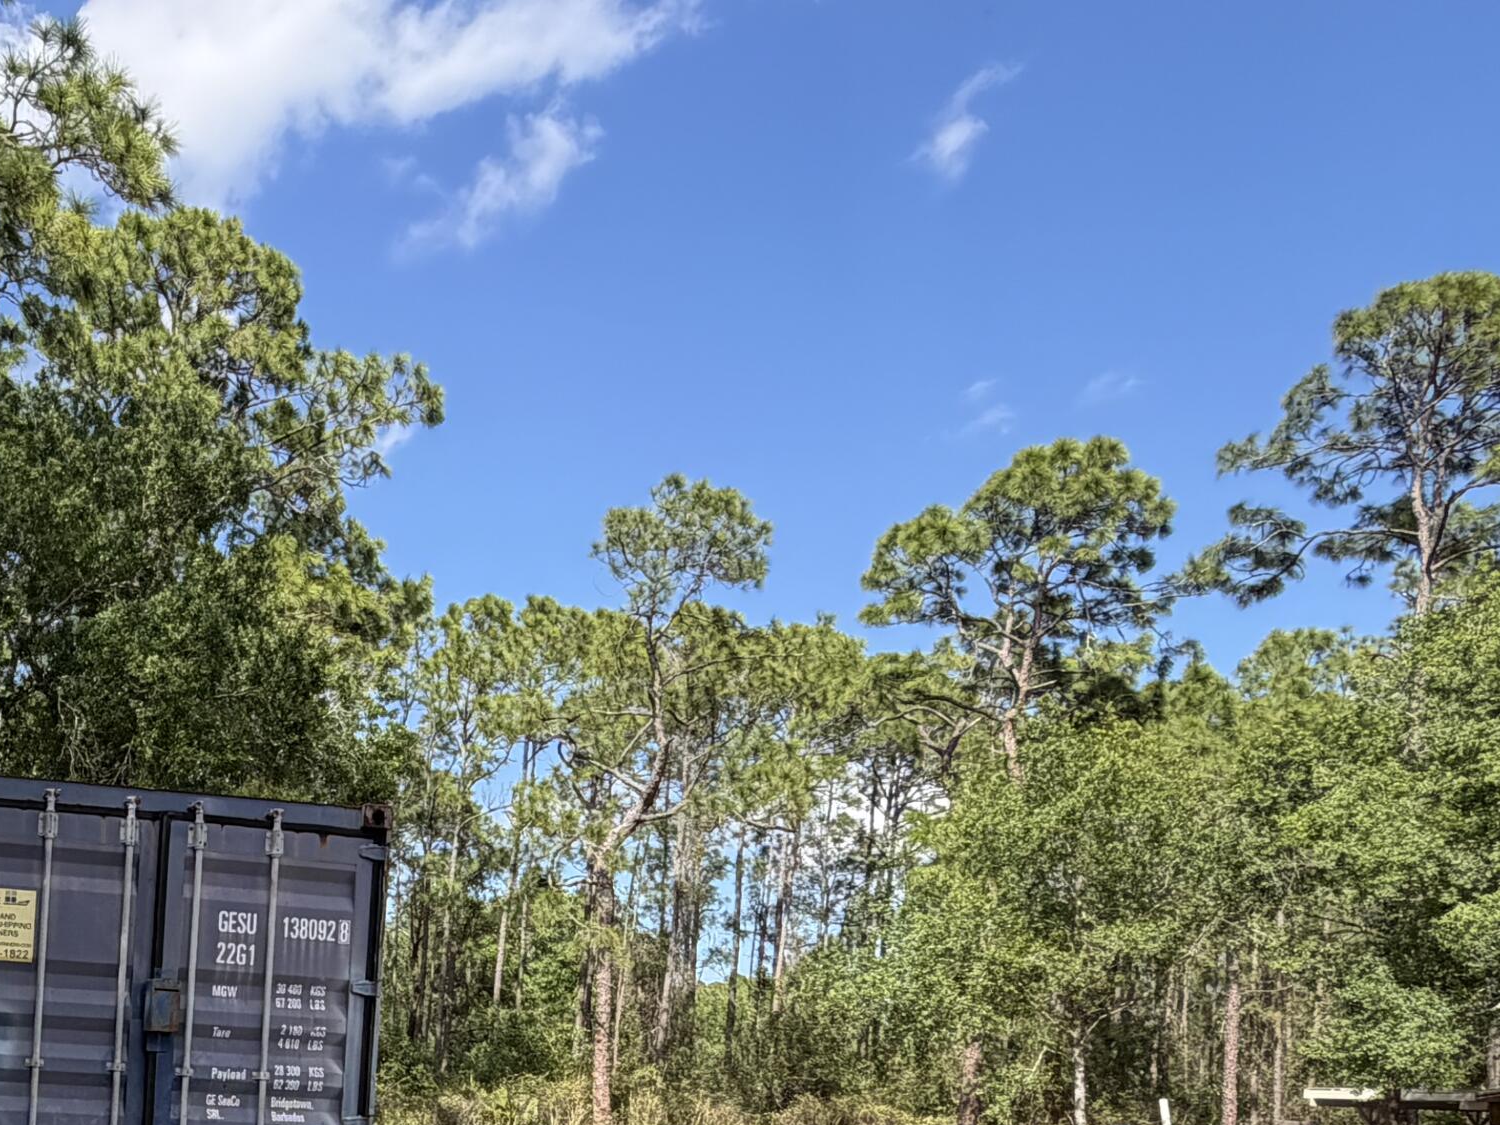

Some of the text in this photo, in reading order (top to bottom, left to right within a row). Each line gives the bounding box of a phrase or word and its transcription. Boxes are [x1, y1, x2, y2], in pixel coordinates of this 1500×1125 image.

[218, 911, 257, 934] GESU
[216, 942, 255, 966] 22G1
[212, 985, 238, 997] MGW
[310, 999, 326, 1010] LBS
[212, 1027, 231, 1038] Tare
[308, 1040, 323, 1051] LBS
[211, 1067, 247, 1081] Payload
[308, 1066, 324, 1078] KGS
[307, 1081, 324, 1092] LBS
